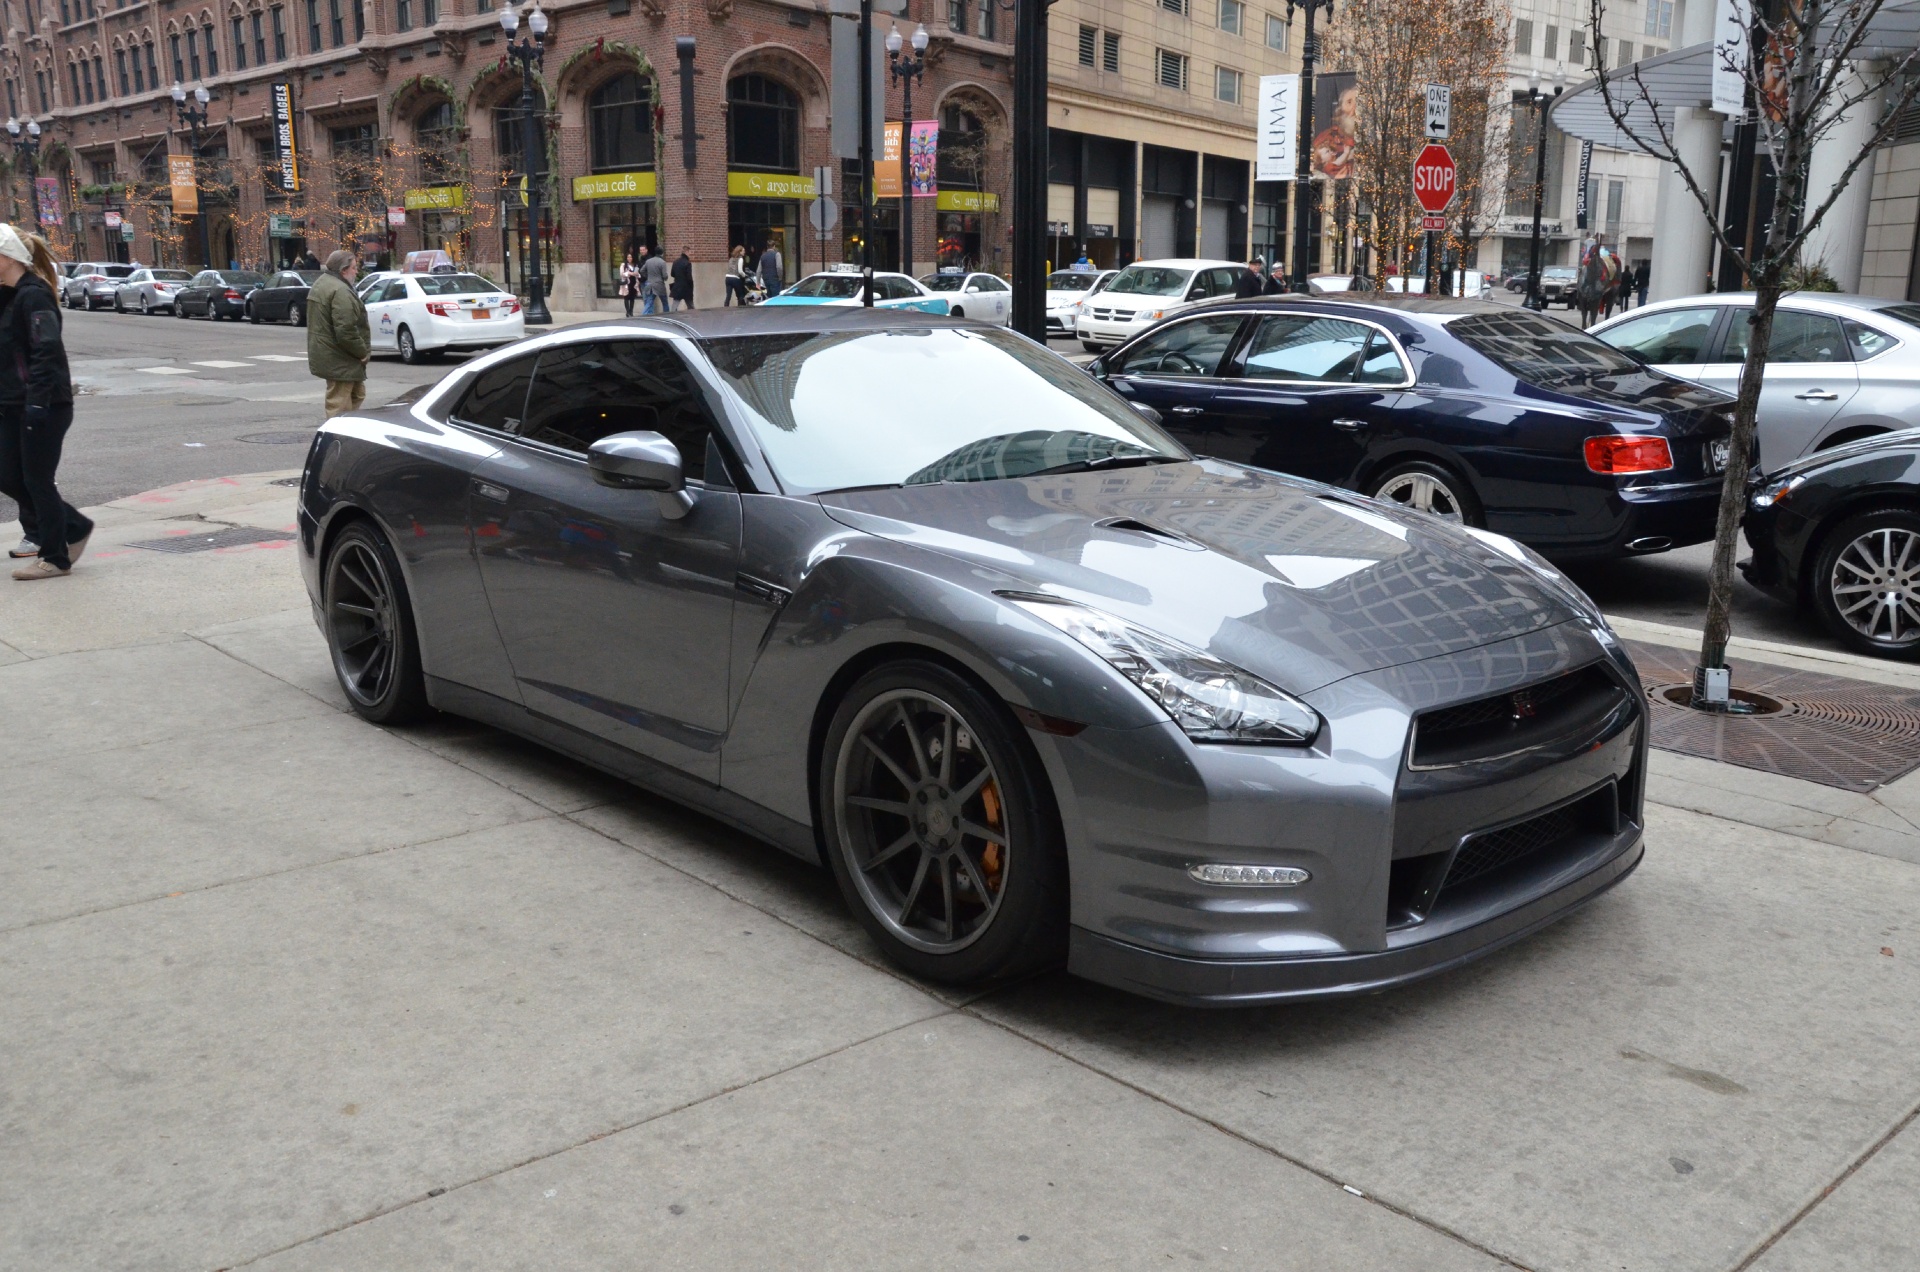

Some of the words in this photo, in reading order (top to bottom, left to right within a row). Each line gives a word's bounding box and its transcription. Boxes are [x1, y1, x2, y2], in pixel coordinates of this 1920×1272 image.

[276, 85, 289, 120] BAGELS
[1429, 88, 1448, 103] ONE
[1428, 103, 1448, 117] WAY
[279, 122, 291, 147] BROS.
[1268, 88, 1287, 160] LUMA
[1579, 140, 1591, 189] ORDSTROM
[596, 181, 609, 193] tea
[611, 174, 637, 192] café
[767, 181, 788, 196] argo
[790, 181, 802, 193] tea
[1416, 165, 1454, 192] STOP
[1577, 191, 1587, 216] rack
[1424, 220, 1433, 228] ALL
[1434, 220, 1444, 228] WAY
